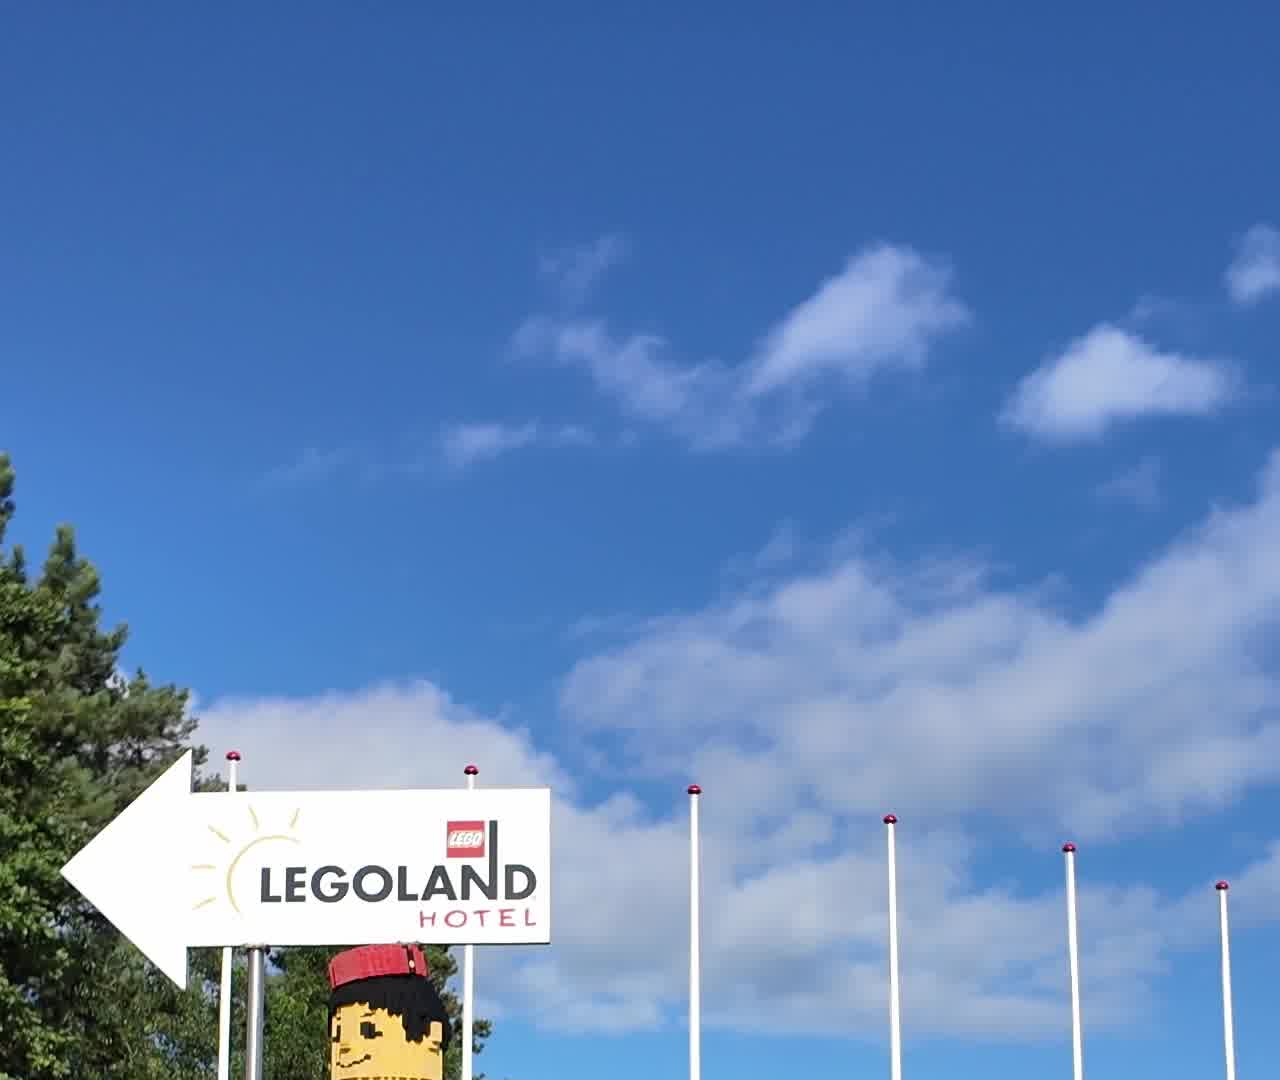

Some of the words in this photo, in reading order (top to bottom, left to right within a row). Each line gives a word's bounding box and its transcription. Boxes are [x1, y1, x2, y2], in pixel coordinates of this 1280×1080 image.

[447, 830, 485, 849] LEGO
[260, 820, 536, 903] LEGOLAND
[419, 908, 537, 928] HOTEL
